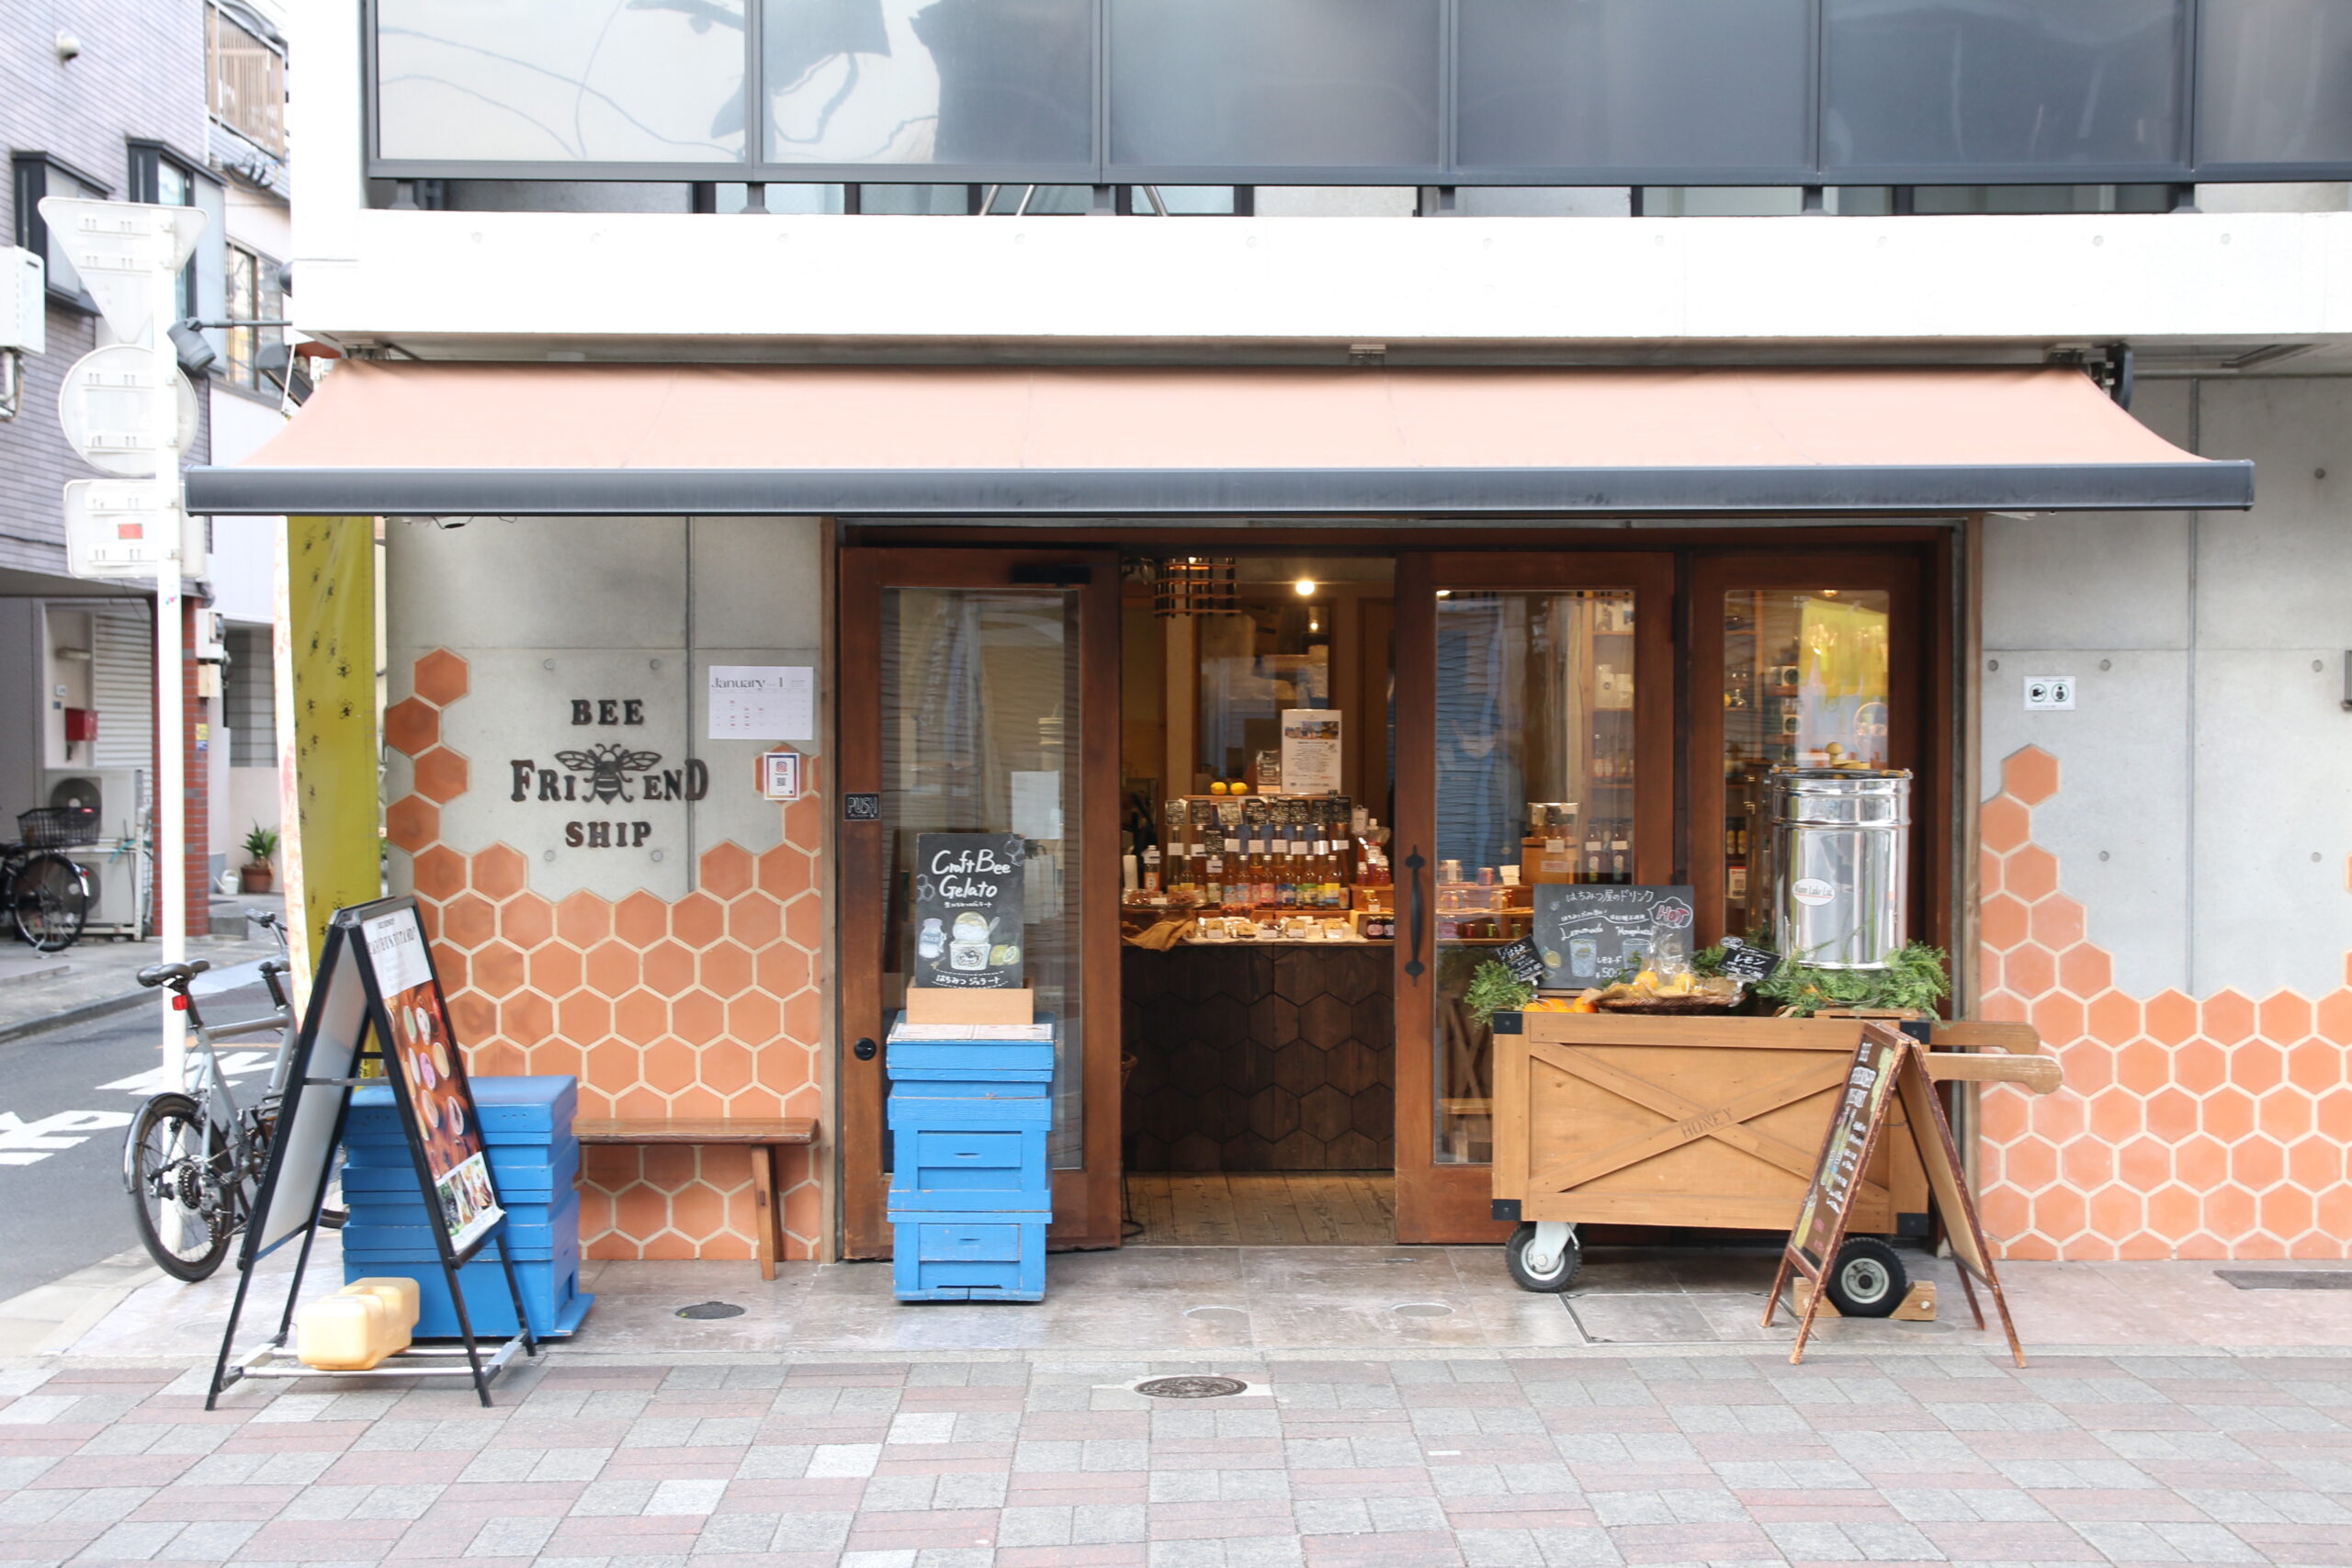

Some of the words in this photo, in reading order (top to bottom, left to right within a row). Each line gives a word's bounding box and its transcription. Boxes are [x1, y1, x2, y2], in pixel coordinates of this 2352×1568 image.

[711, 677, 765, 691] January
[571, 699, 644, 726] BEE
[848, 796, 878, 814] PUSH
[565, 821, 652, 848] SHIP
[931, 850, 975, 874] Craft
[975, 849, 1012, 874] Bee
[939, 874, 998, 899] Gelato
[1734, 954, 1766, 965] レモン
